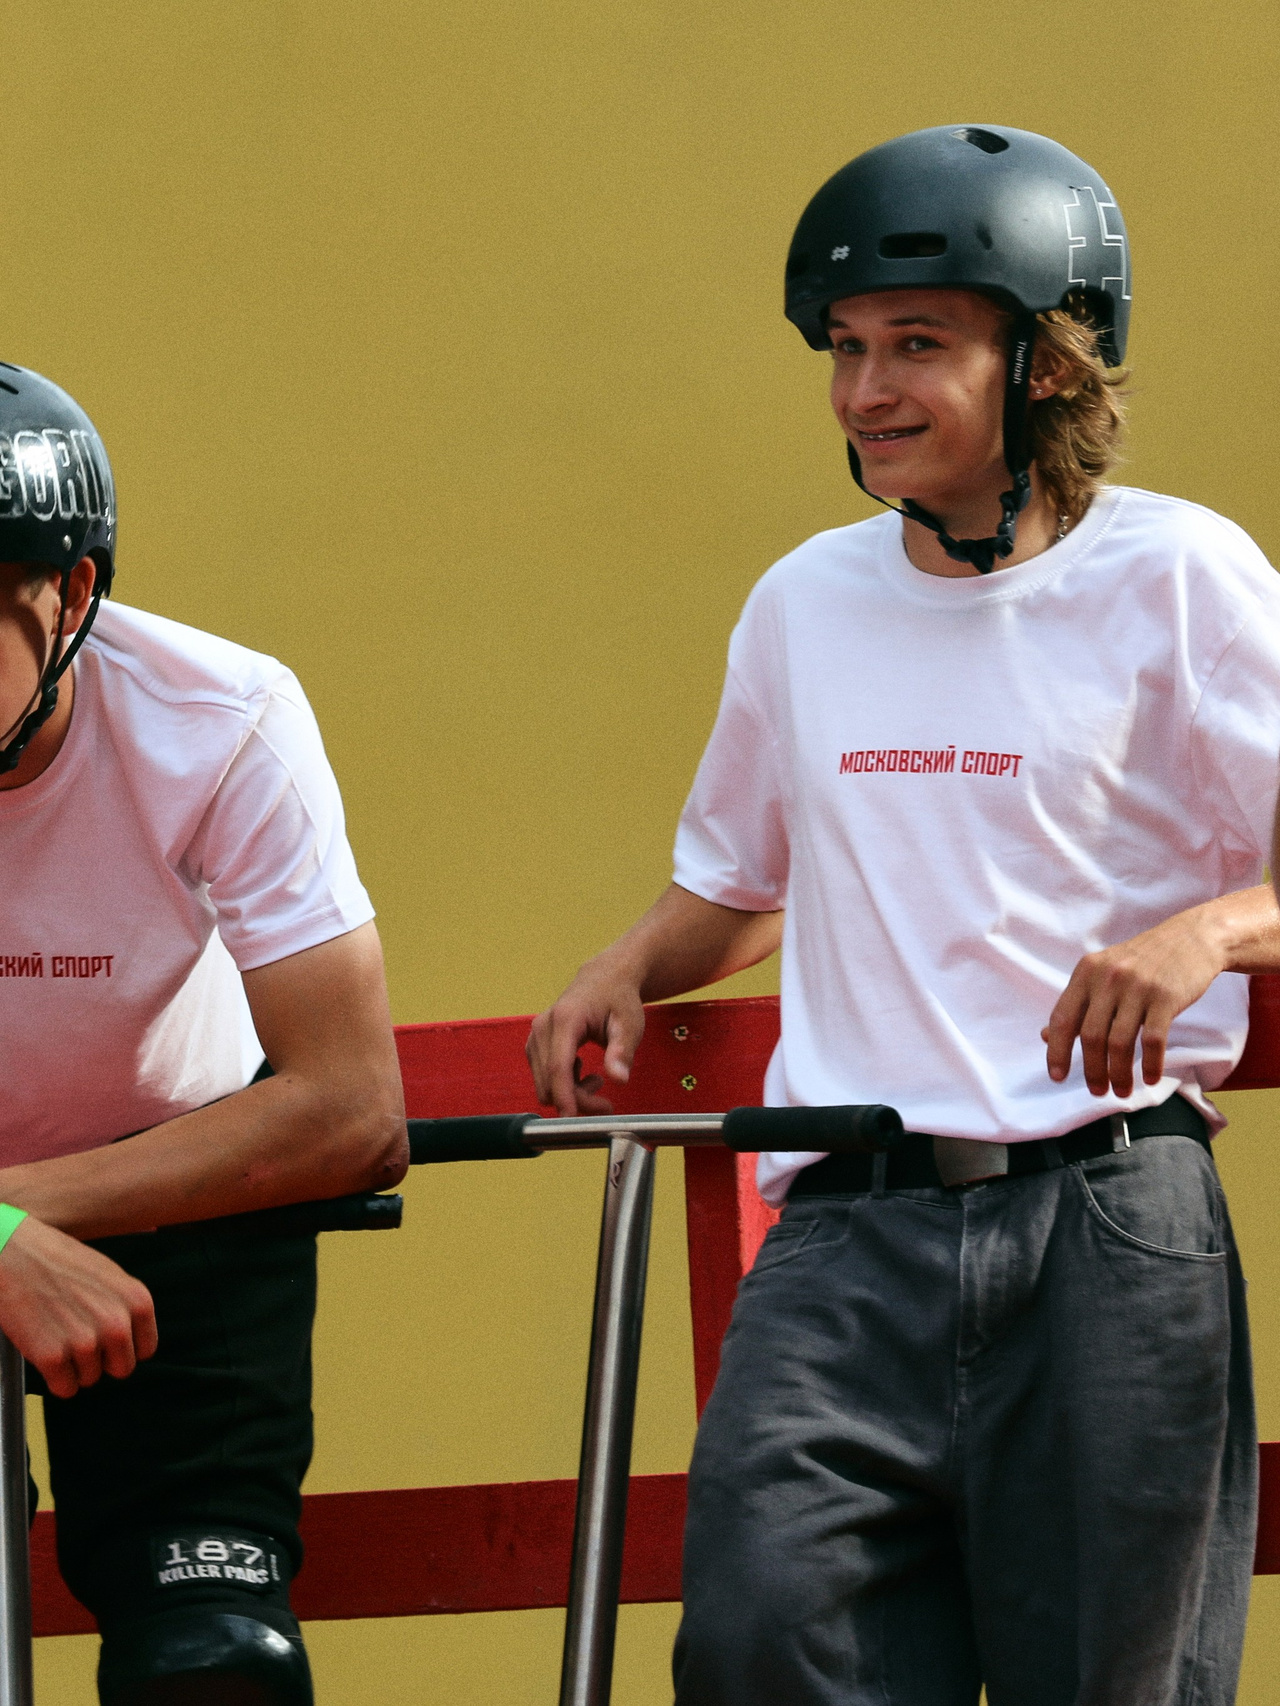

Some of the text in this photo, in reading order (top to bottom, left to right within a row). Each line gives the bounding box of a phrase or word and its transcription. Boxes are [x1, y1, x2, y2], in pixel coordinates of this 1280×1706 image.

[839, 745, 1023, 777] МОСКОВСКИЙ СПОРТ
[51, 955, 114, 978] СПОРТ
[165, 1540, 263, 1565] 187
[158, 1564, 222, 1584] KILLER
[223, 1565, 269, 1584] PADS
